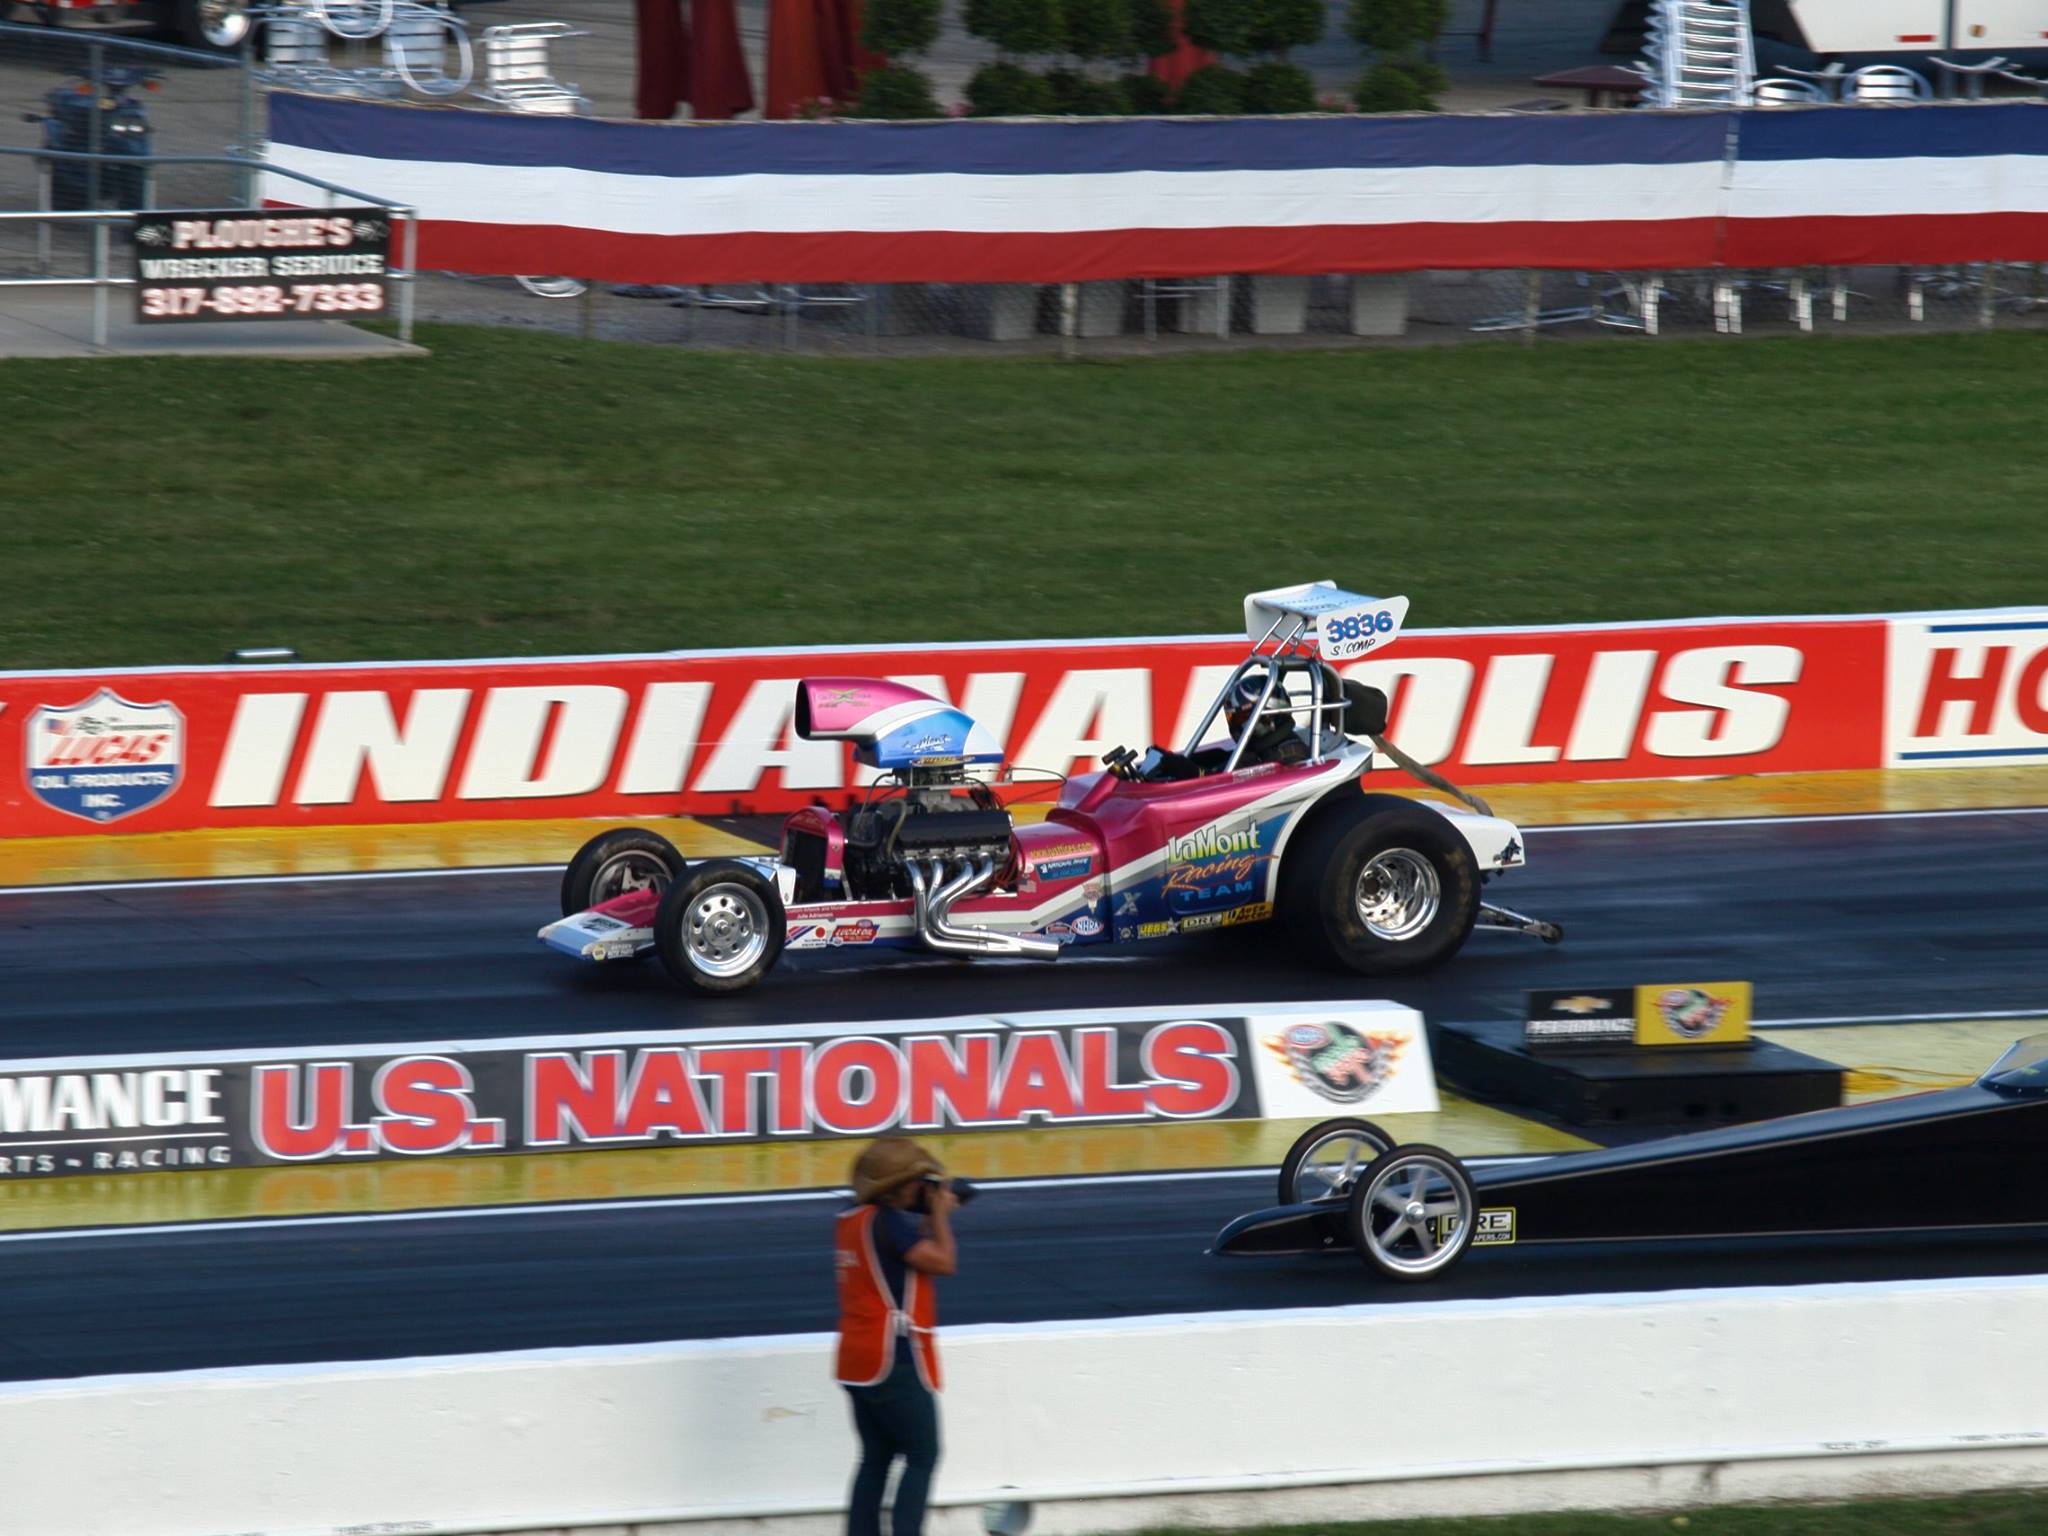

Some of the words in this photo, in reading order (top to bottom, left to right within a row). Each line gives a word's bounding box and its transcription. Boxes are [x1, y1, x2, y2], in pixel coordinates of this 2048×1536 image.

[172, 218, 354, 249] PLOUGHE'S
[139, 258, 269, 279] WRECKER
[272, 254, 385, 276] SERVICE
[141, 283, 384, 316] 317-892-7333
[1326, 610, 1394, 643] 3836
[46, 734, 171, 766] LUCAS
[1168, 820, 1261, 862] LaMont
[1158, 853, 1280, 898] Racing
[1180, 881, 1253, 901] TEAM
[1077, 918, 1099, 931] NHRA
[0, 1069, 225, 1132] MANCE
[251, 1055, 506, 1160] U.S.
[524, 1020, 1242, 1146] NATIONALS
[93, 1146, 231, 1169] RACING
